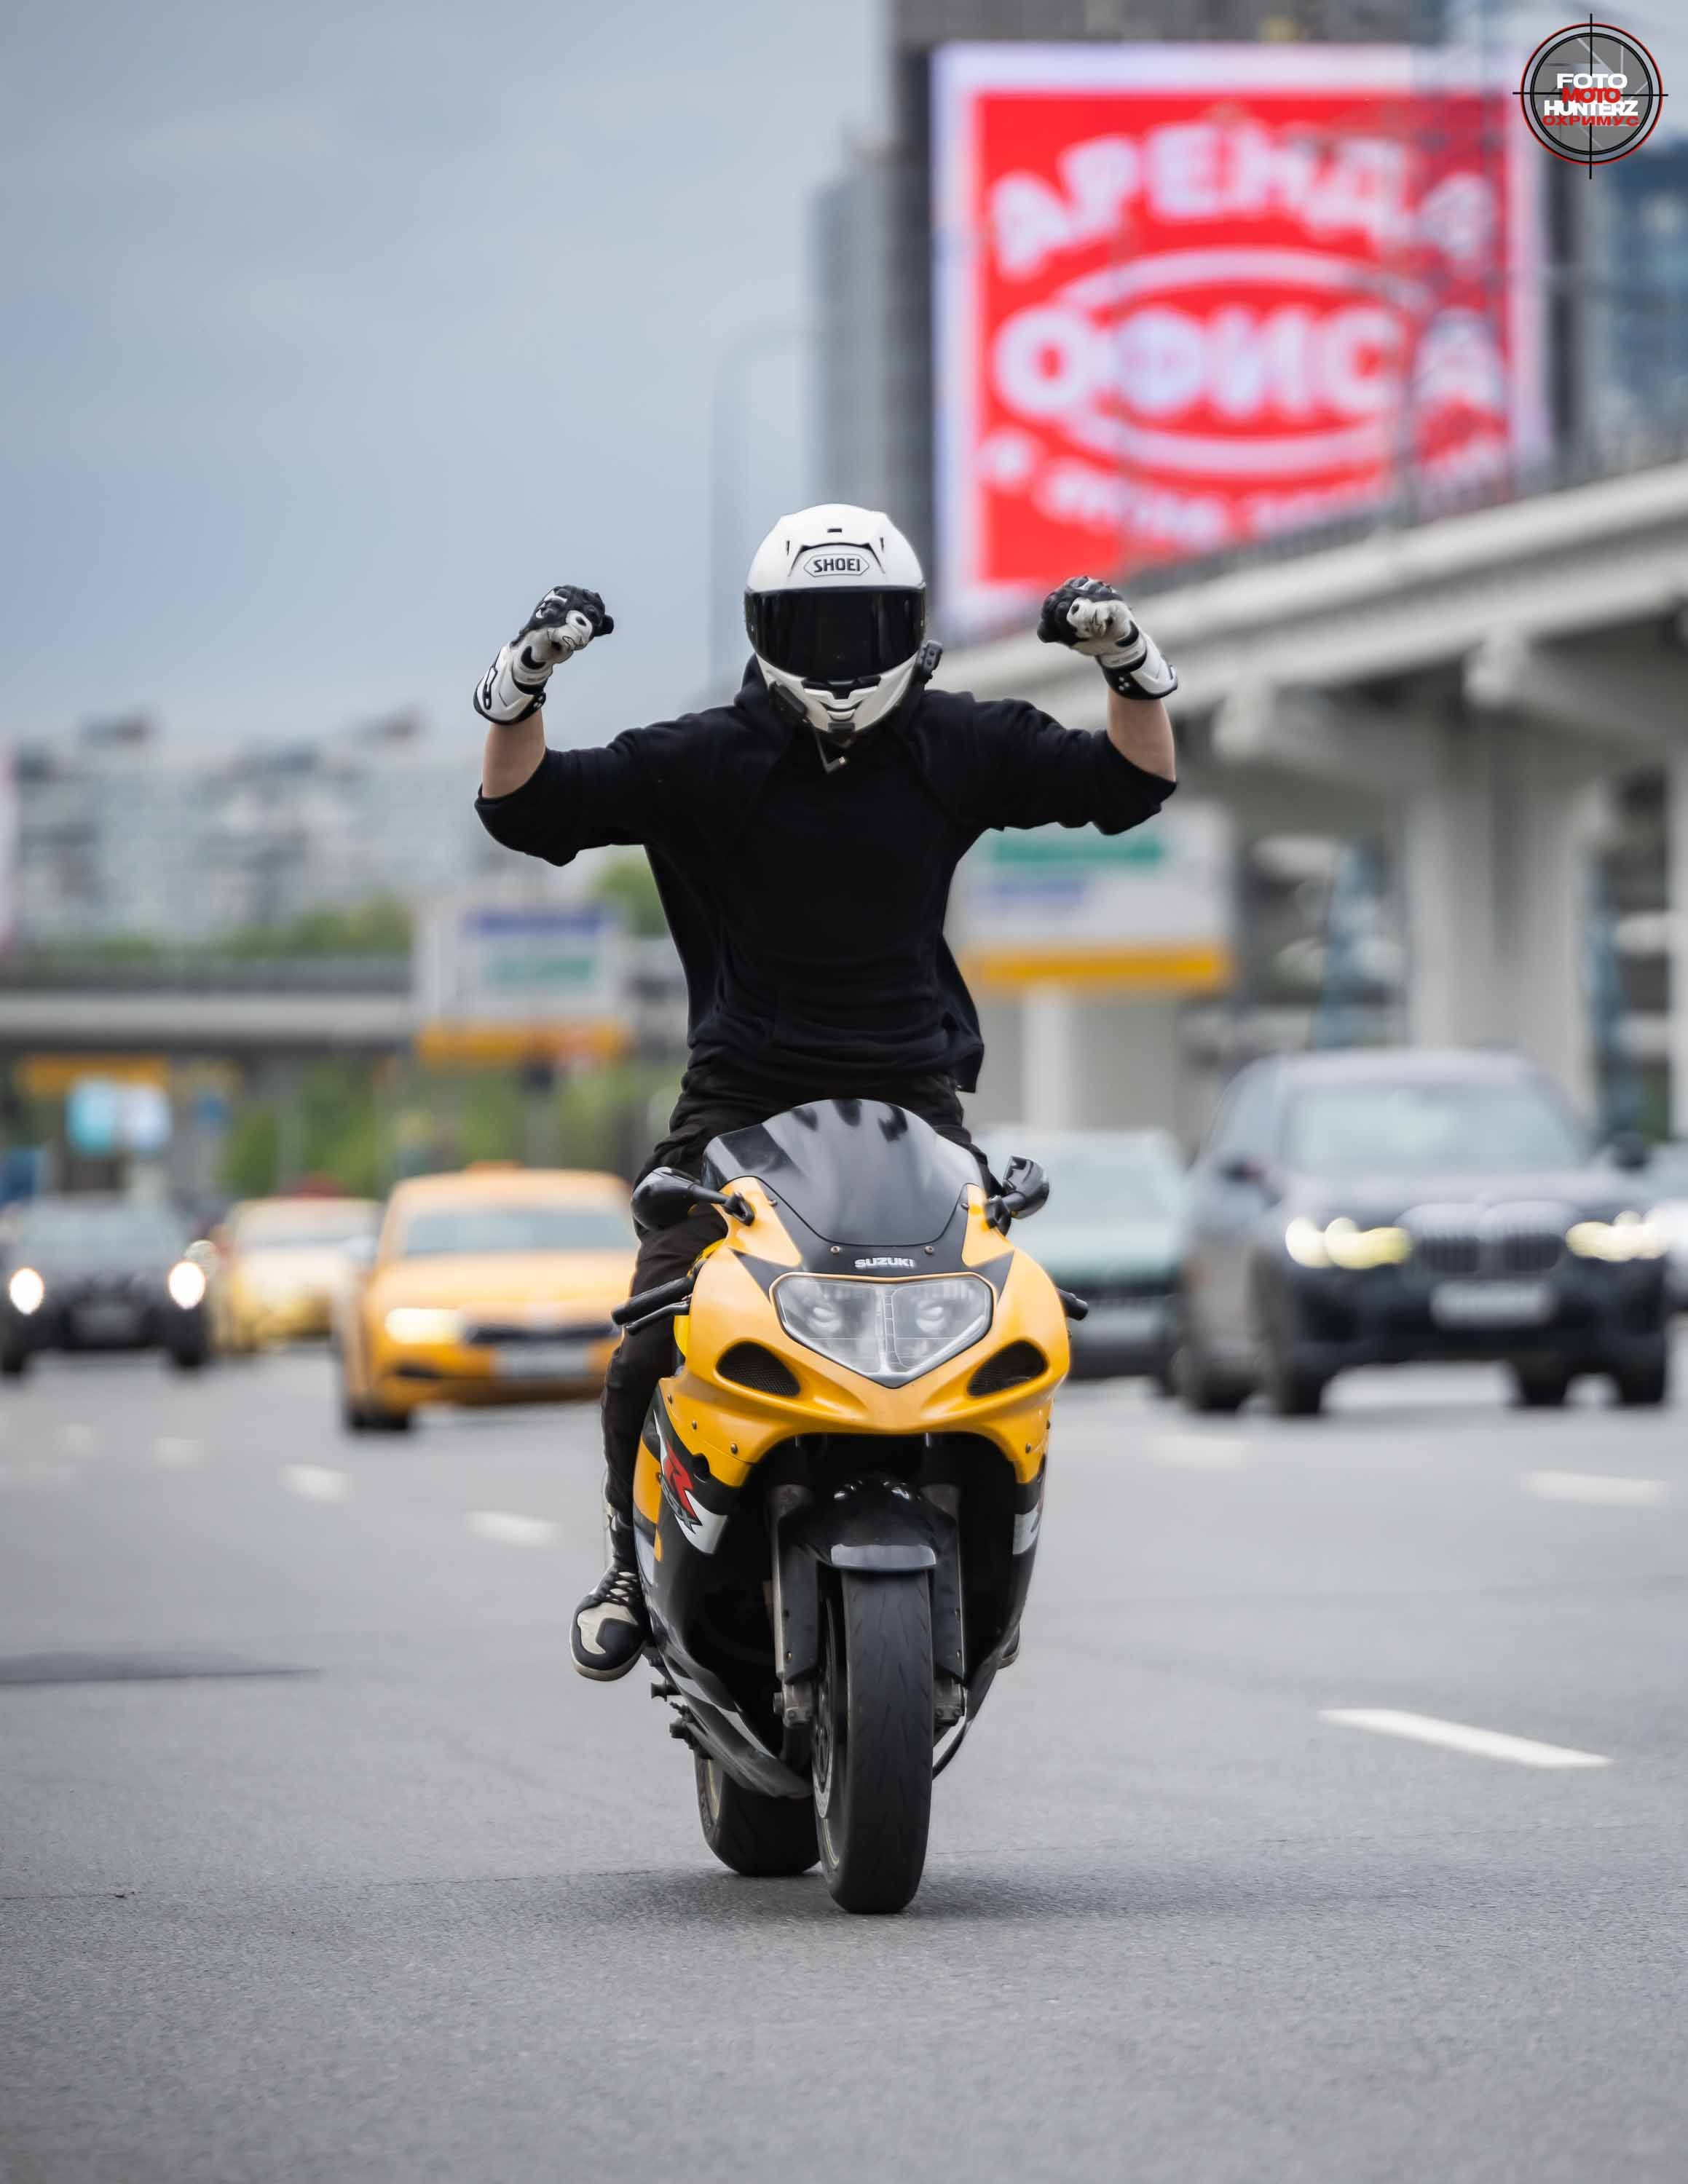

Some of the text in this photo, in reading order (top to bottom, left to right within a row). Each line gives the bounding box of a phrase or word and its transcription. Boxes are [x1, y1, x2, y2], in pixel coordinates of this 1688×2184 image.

[995, 304, 1502, 415] ОФИСА
[813, 558, 860, 573] SHOEI
[854, 1257, 915, 1267] SUZUKI
